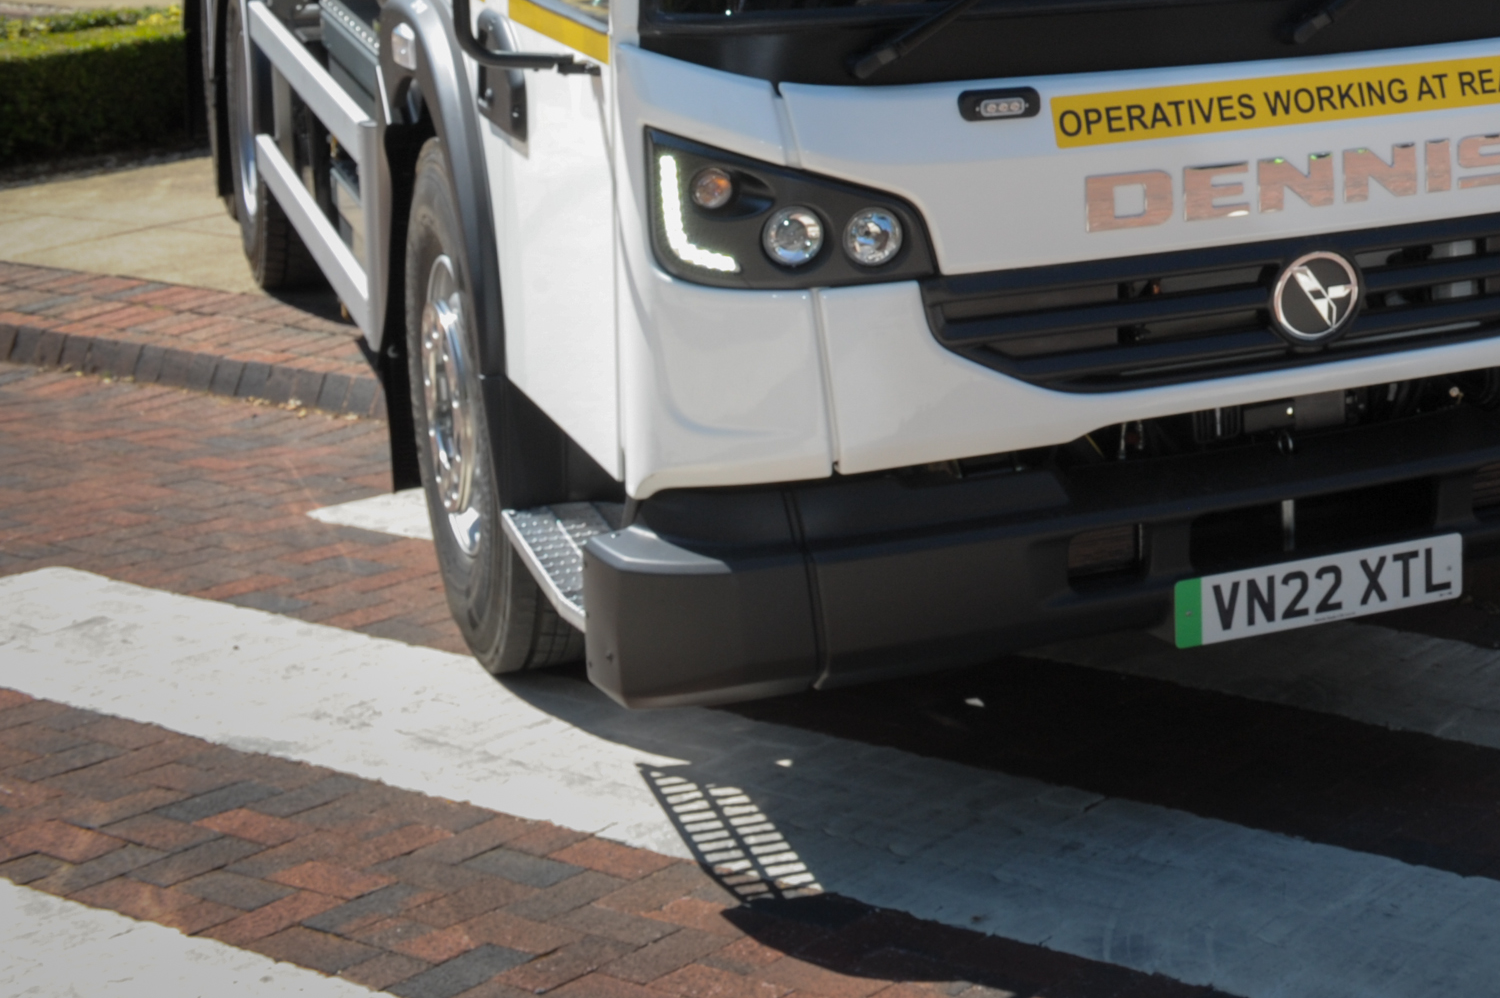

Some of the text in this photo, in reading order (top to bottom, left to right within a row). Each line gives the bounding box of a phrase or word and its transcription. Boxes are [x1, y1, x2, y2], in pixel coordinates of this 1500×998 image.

[1058, 93, 1257, 138] OPERATIVES
[1263, 76, 1409, 118] WORKING
[1416, 73, 1449, 102] AT
[1212, 546, 1452, 631] VN22 XTL
